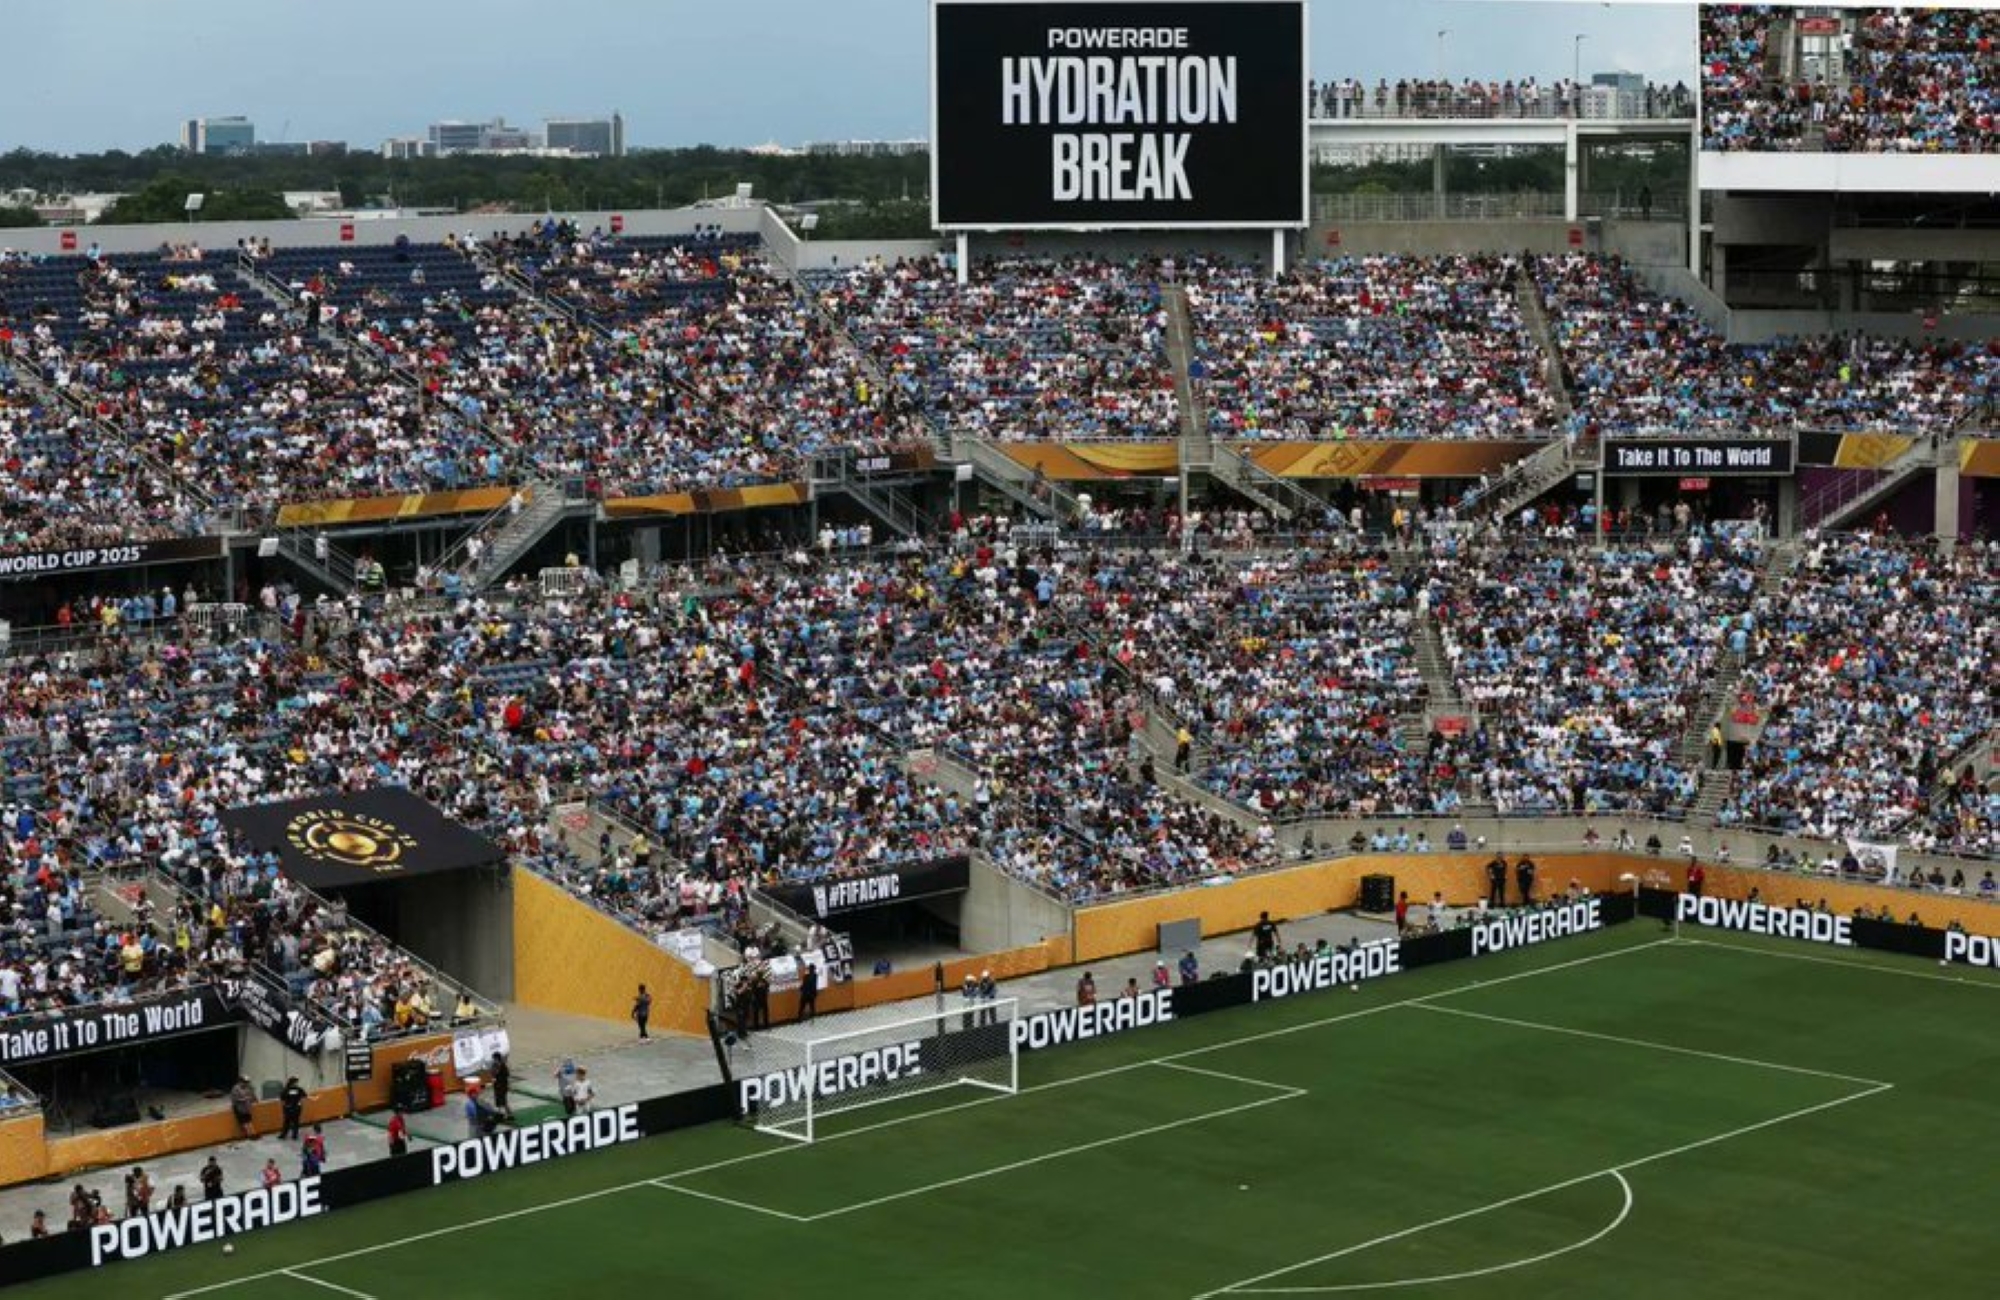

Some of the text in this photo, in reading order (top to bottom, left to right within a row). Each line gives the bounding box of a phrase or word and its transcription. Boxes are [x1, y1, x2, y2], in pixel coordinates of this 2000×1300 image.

[1048, 28, 1188, 48] POWERADE
[1002, 55, 1238, 125] HYDRATION
[1053, 132, 1193, 200] BREAK
[1618, 446, 1771, 466] Take It To The World
[62, 549, 97, 568] CUP
[828, 873, 900, 908] #FIFACWC
[1677, 892, 1852, 946] POWERADE
[1471, 898, 1601, 957] POWERADE
[1945, 930, 2000, 968] PO
[1252, 942, 1400, 1002] POWERADE
[0, 1028, 49, 1060] Take
[53, 1021, 69, 1050] It
[73, 1018, 98, 1047] To
[102, 1011, 140, 1042] The
[144, 997, 203, 1034] World
[1008, 989, 1173, 1055] POWERADE
[740, 1041, 922, 1115] POWERADE
[432, 1102, 639, 1186] POWERADE
[90, 1175, 322, 1267] POWERADE
